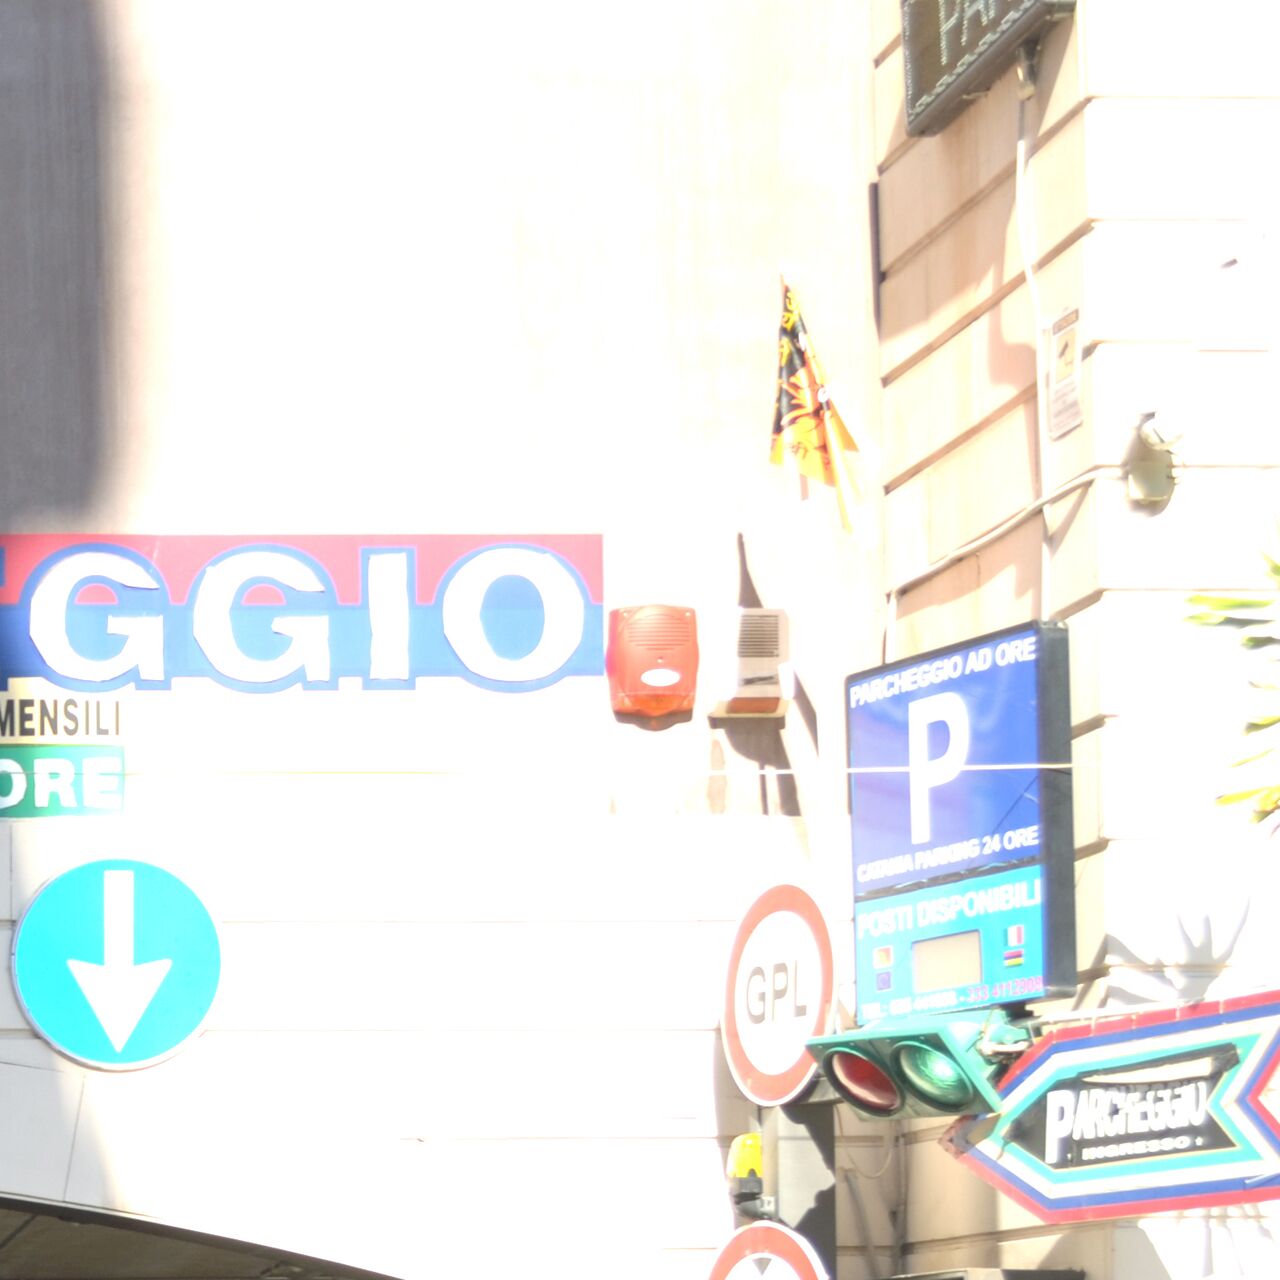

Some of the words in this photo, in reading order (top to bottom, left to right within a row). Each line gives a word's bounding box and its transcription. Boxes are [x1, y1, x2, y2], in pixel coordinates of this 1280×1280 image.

[849, 657, 962, 708] PARCHEGGIO
[964, 647, 993, 676] AD
[994, 636, 1037, 666] ORE
[907, 690, 971, 846] P
[914, 837, 981, 872] PARKING
[981, 832, 1002, 855] 24
[1003, 825, 1040, 850] ORE
[856, 898, 914, 939] POSTI
[917, 878, 1043, 931] DISPONIBILI
[746, 959, 807, 1025] GPL
[1081, 1135, 1191, 1161] INGRESSO
